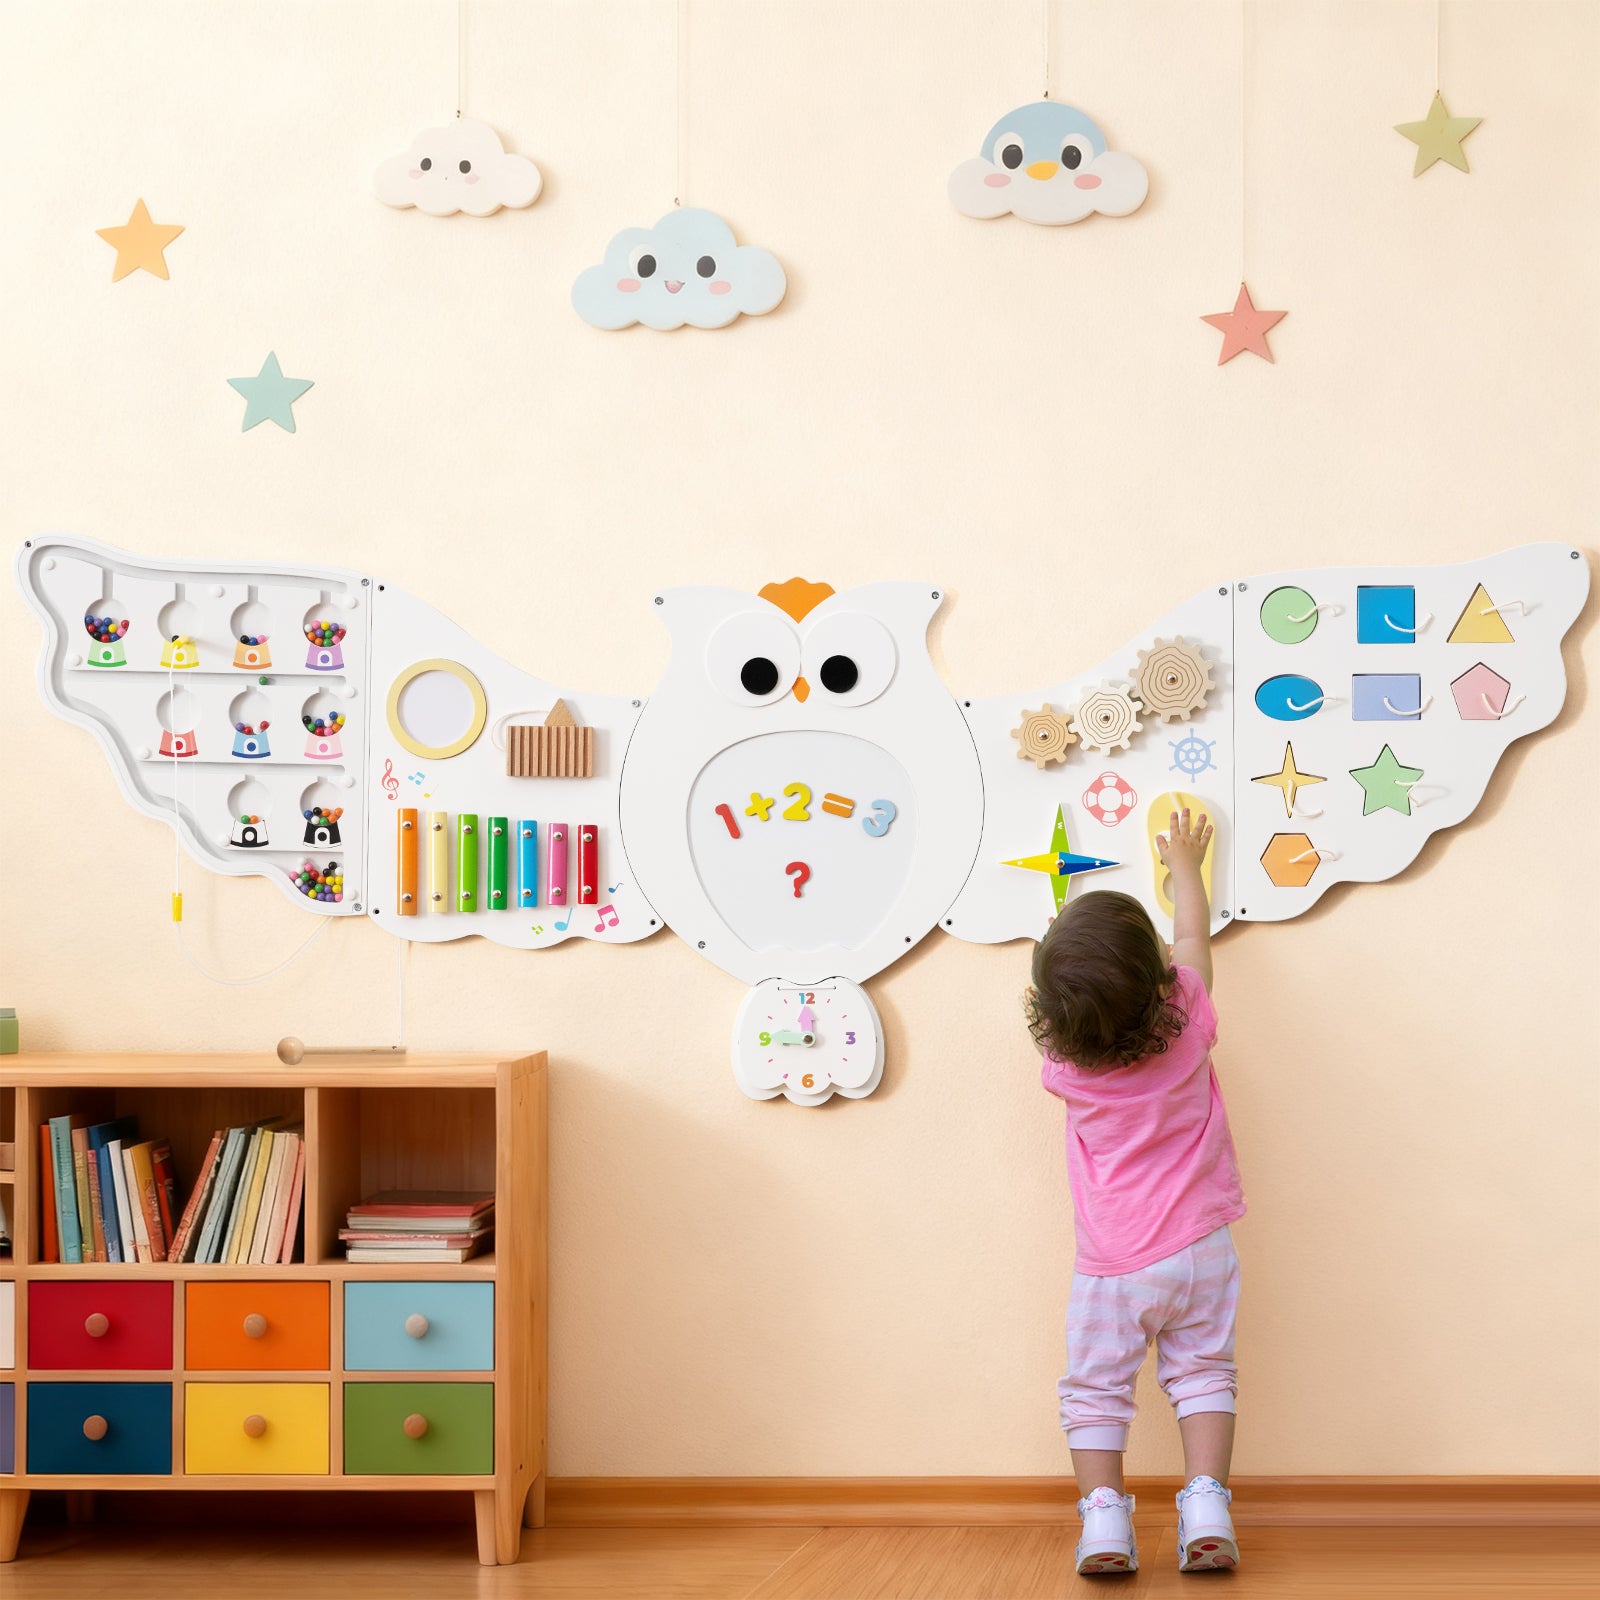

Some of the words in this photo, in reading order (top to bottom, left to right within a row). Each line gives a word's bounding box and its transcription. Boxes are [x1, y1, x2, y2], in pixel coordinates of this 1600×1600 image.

[715, 803, 741, 839] 1
[783, 782, 811, 821] 2
[862, 799, 896, 837] 3
[785, 861, 811, 898] ?
[798, 992, 816, 1005] 12
[759, 1031, 772, 1047] 9
[845, 1031, 856, 1045] 3
[801, 1073, 815, 1089] 6
